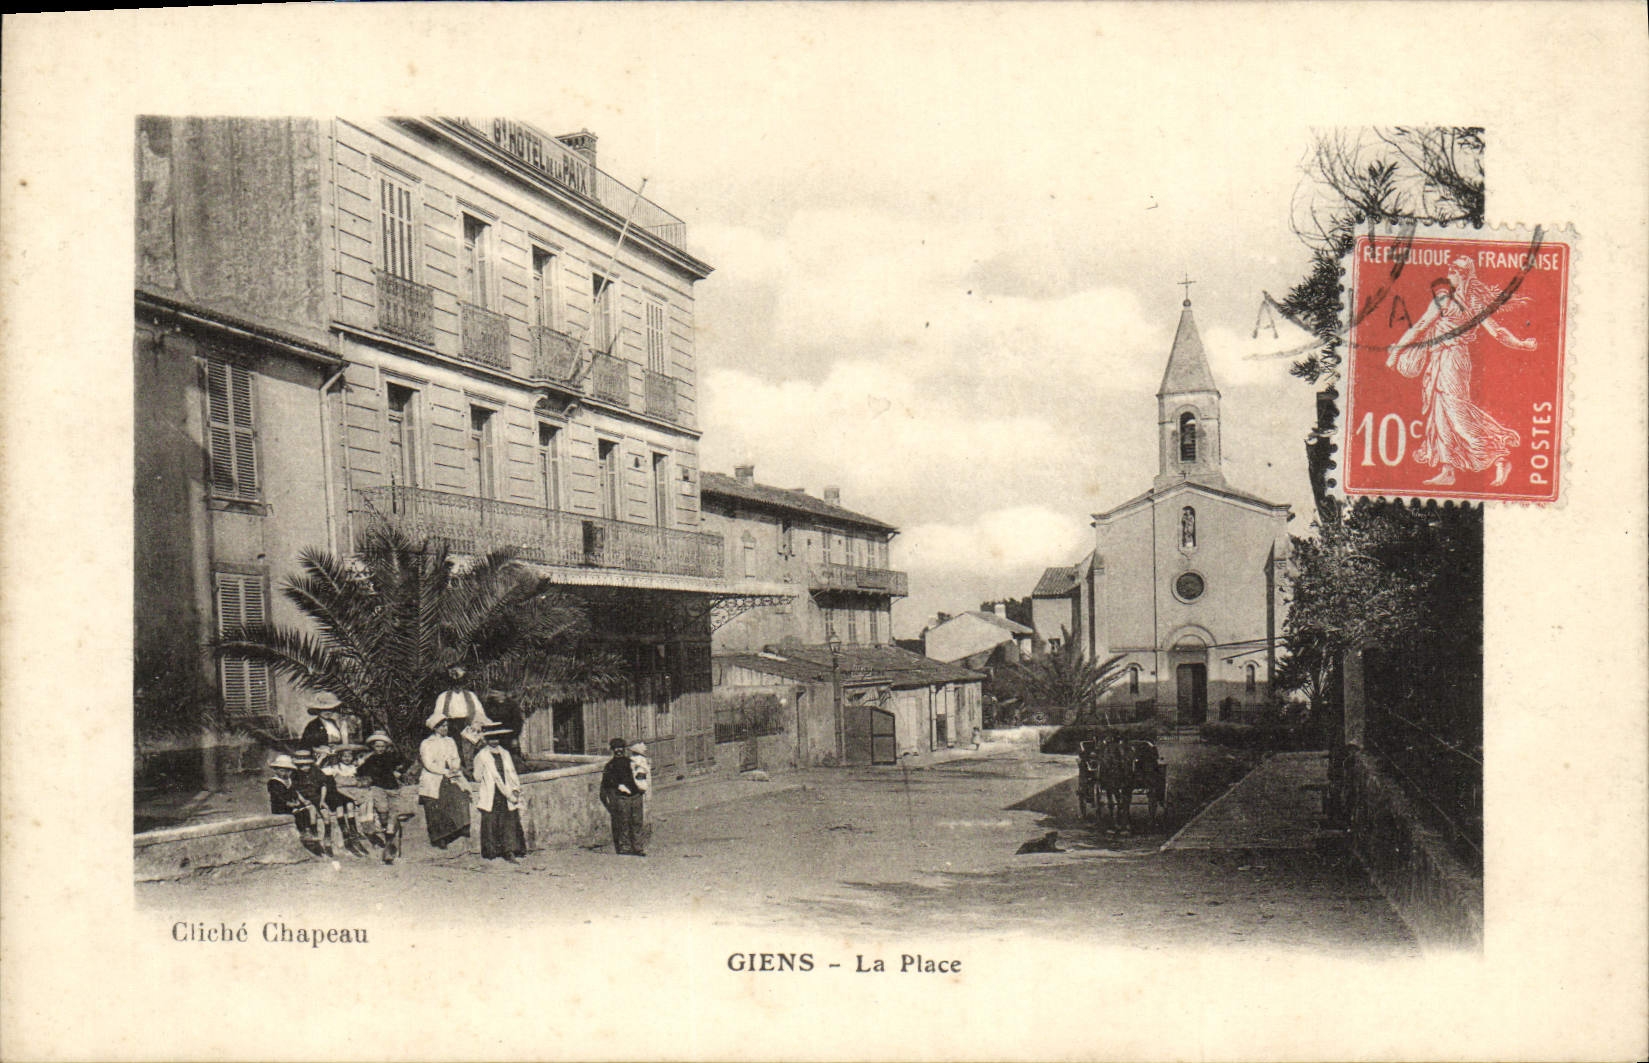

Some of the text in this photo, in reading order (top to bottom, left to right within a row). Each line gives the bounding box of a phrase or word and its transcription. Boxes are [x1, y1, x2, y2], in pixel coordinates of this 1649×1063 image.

[508, 120, 546, 170] HOTEL
[563, 154, 588, 194] PAIX
[1530, 401, 1552, 485] POSTES
